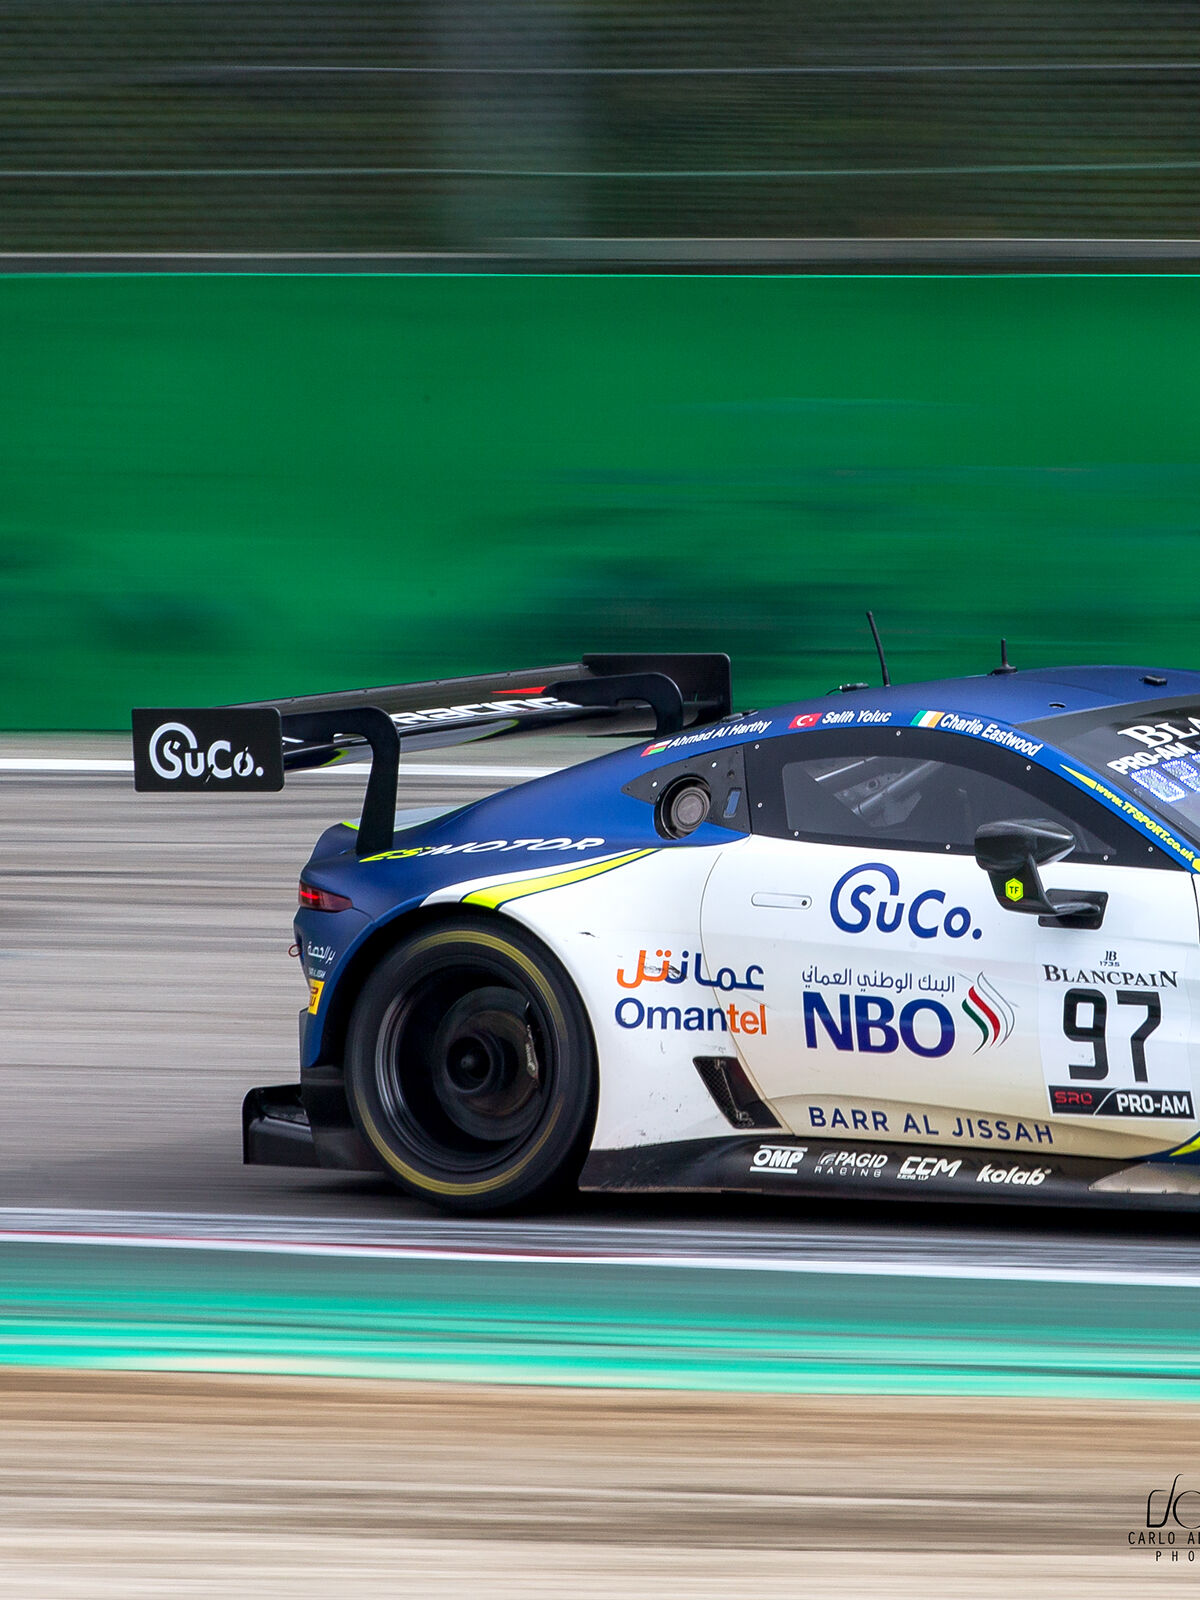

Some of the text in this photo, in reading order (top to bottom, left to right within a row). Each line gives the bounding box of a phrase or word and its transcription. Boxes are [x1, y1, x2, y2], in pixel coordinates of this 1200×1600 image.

[821, 709, 893, 724] Salih Yoluc
[668, 719, 773, 748] Ahmad Al Harthy
[939, 712, 1045, 758] Charlie Eastwood
[1106, 741, 1197, 776] PRO-AM
[1095, 783, 1196, 862] www.TFSPORT.co.uk
[616, 949, 765, 992] عمانتل
[802, 964, 852, 989] العماني
[857, 970, 912, 993] الوطني
[1042, 964, 1179, 989] BLANCPAIN
[614, 997, 768, 1036] Omantel
[802, 991, 957, 1059] NBO
[1062, 988, 1163, 1084] 97
[1054, 1091, 1191, 1116] SRO PRO-AM
[808, 1106, 1054, 1145] BARR AL JISSAH
[753, 1149, 805, 1169] OMP
[834, 1151, 889, 1169] PAGID
[899, 1156, 963, 1177] CCM
[813, 1166, 882, 1178] RACING
[976, 1164, 1048, 1186] kolab
